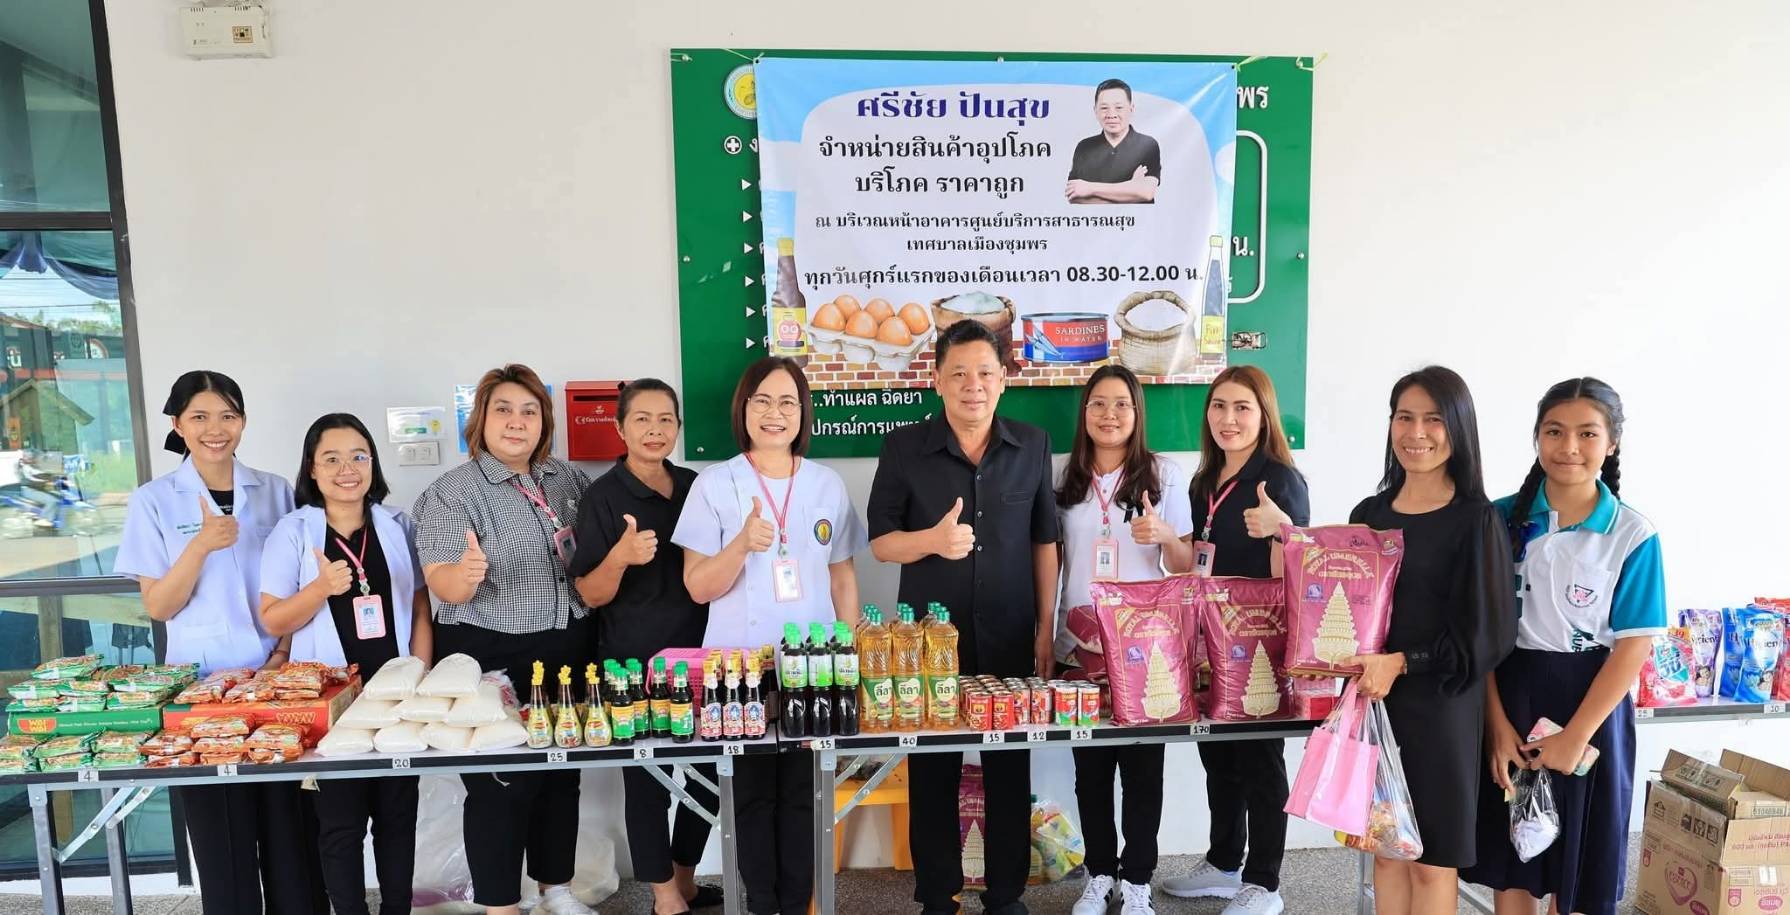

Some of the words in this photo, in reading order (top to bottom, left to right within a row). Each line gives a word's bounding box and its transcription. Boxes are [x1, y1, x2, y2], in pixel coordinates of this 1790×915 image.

[856, 90, 947, 118] ศรีชัย
[959, 90, 1050, 127] ปันสุข
[819, 131, 1051, 164] จำหน่ายสินค้าอุปโภค
[855, 165, 928, 192] บริโภค
[936, 175, 1024, 200] ราคาถูก
[815, 216, 831, 228] ณ
[835, 211, 1136, 231] บริเวณหน้าอาคารศูนย์บริการสาธารณสุข
[906, 236, 1048, 255] เทศบาลเมืองชุมพร
[804, 264, 1061, 291] ทุกวันศุกร์แรกของเดือนเวลา
[1066, 264, 1180, 283] 08.30-12.00
[1185, 267, 1203, 281] น.
[1055, 324, 1105, 336] SARDINES
[881, 388, 922, 405] ฉีดยา
[1076, 731, 1089, 739] 15
[1193, 725, 1210, 735] 170
[989, 733, 1000, 743] 15
[1032, 731, 1045, 740] 12
[820, 740, 832, 749] 15
[902, 736, 916, 746] 40
[639, 748, 647, 758] 8
[728, 745, 740, 755] 18
[550, 752, 564, 762] 25
[394, 758, 410, 768] 20
[223, 765, 233, 775] 4
[83, 771, 93, 782] 4
